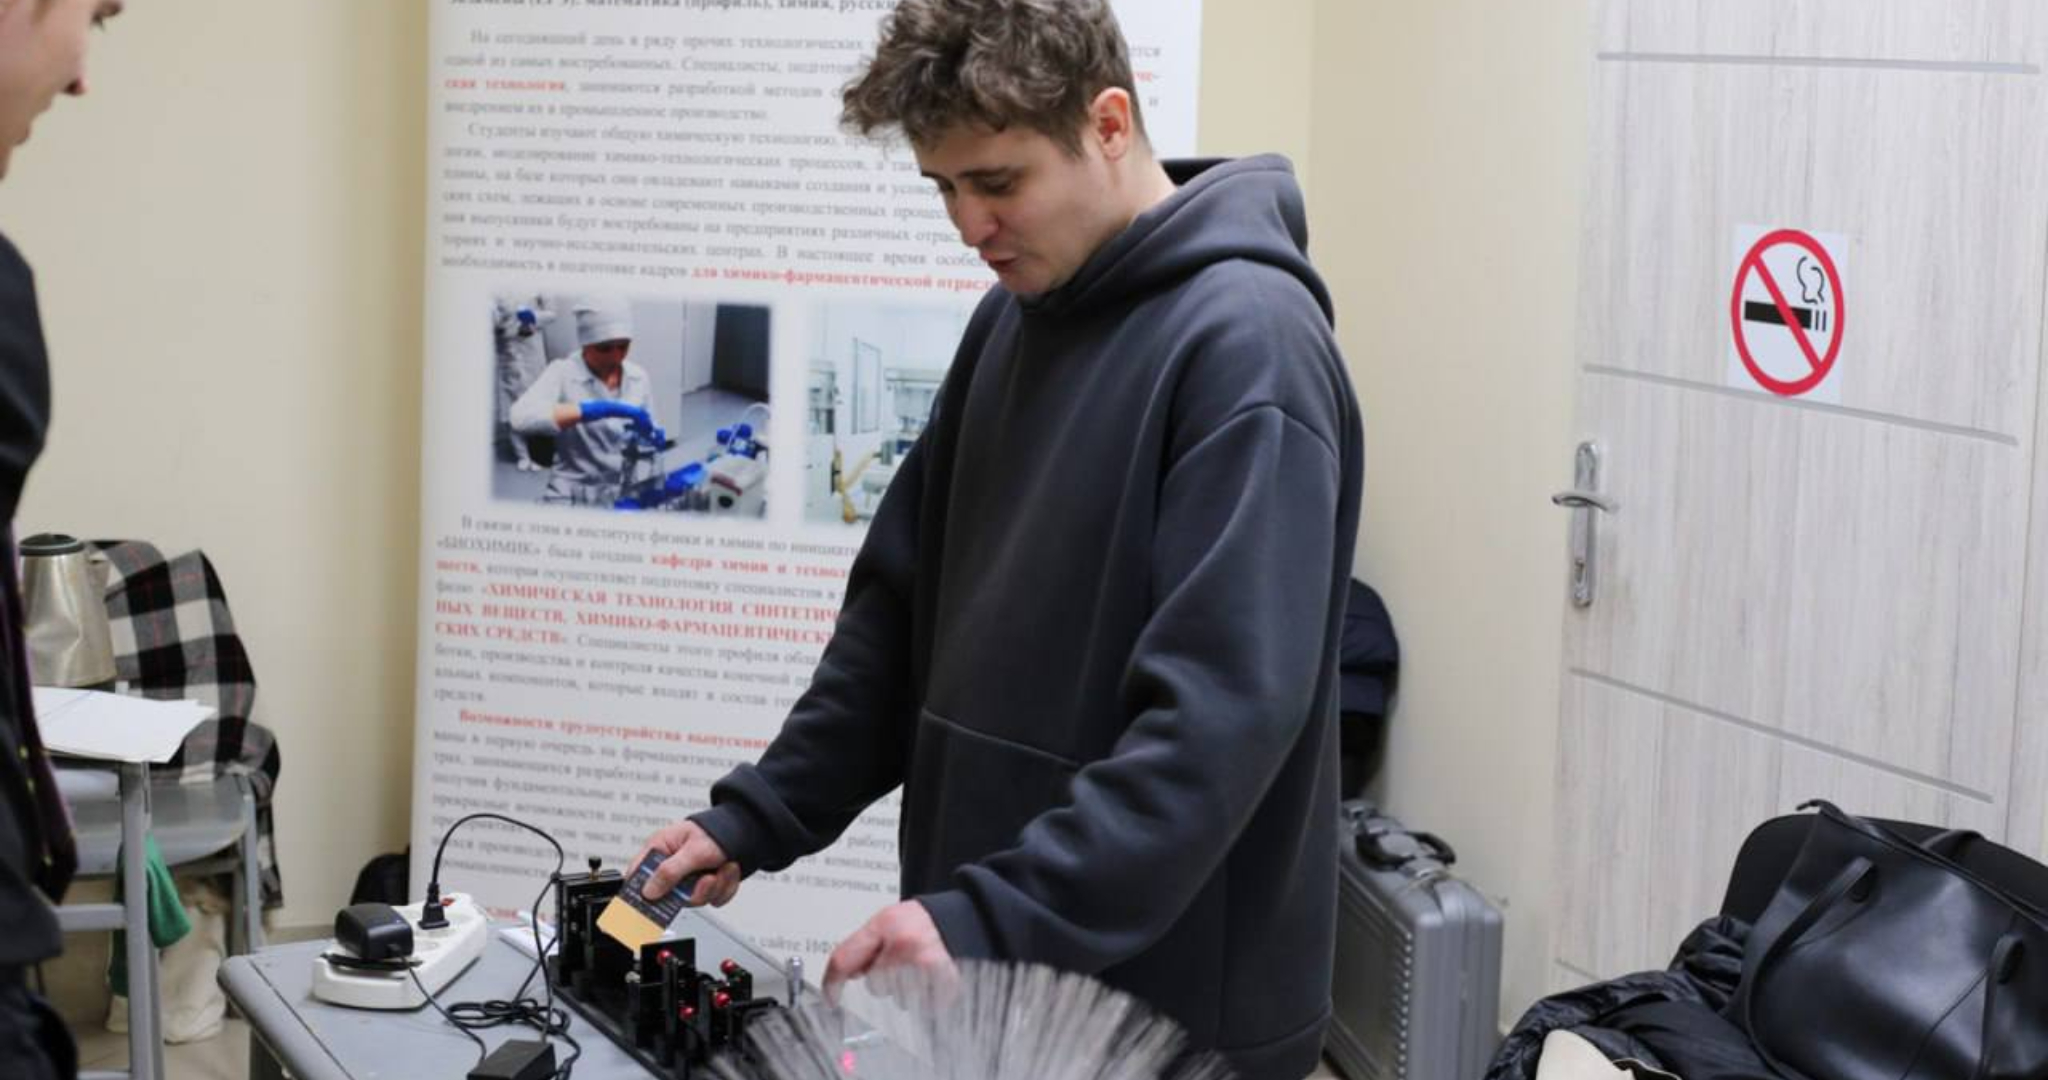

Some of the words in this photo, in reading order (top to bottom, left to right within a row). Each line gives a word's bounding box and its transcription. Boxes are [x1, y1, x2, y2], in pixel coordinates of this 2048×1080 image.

[839, 0, 895, 13] русски
[643, 36, 676, 49] ряду
[681, 57, 781, 73] Специалисты,
[788, 63, 858, 74] подготов
[667, 82, 755, 97] разработкой
[467, 122, 536, 138] Студенты
[540, 127, 597, 140] изучают
[601, 126, 651, 142] общую
[656, 131, 744, 145] химическую
[605, 151, 781, 166] химико-технологических
[790, 157, 865, 170] процессов,
[495, 171, 511, 181] на
[515, 169, 543, 182] базе
[550, 173, 605, 187] которых
[611, 175, 637, 185] они
[642, 176, 724, 188] овладевают
[730, 179, 800, 190] навыками
[805, 182, 870, 194] создания
[652, 199, 744, 212] современных
[752, 203, 886, 216] производственных
[557, 214, 597, 230] будут
[603, 218, 700, 232] востребованы
[704, 222, 720, 232] на
[726, 223, 825, 237] предприятиях
[832, 227, 910, 240] различных
[512, 237, 696, 254] научно-исследовательских
[797, 249, 873, 262] настоящее
[883, 252, 926, 265] время
[640, 265, 687, 279] кадров
[691, 267, 717, 278] для
[723, 268, 931, 286] химико-фармацевтической
[475, 520, 512, 531] связи
[576, 527, 644, 543] институте
[649, 529, 701, 545] физики
[768, 540, 784, 550] по
[436, 537, 540, 555] «БИОХИМИК»
[589, 550, 643, 563] создана
[651, 553, 712, 570] кафедра
[796, 565, 846, 578] технол
[481, 582, 606, 604] «ХИМИЧЕСКАЯ
[615, 593, 732, 614] ТЕХНОЛОГИЯ
[641, 576, 719, 594] подготовку
[724, 583, 823, 599] специалистов
[435, 599, 473, 614] НЫХ
[482, 603, 565, 622] ВЕЩЕСТВ,
[435, 622, 479, 637] СКИХ
[577, 633, 668, 652] Специалисты
[677, 644, 714, 656] этого
[718, 647, 779, 662] профиля
[480, 649, 572, 666] производства
[590, 658, 651, 674] контроля
[656, 664, 717, 678] качества
[723, 670, 789, 684] конечной
[588, 681, 644, 696] которые
[652, 686, 697, 699] входят
[721, 692, 766, 705] состав
[459, 709, 553, 729] Возможности
[559, 721, 681, 741] трудоустройства
[485, 735, 535, 751] первую
[601, 746, 615, 756] на
[493, 776, 614, 799] фундаментальные
[847, 835, 894, 853] работу
